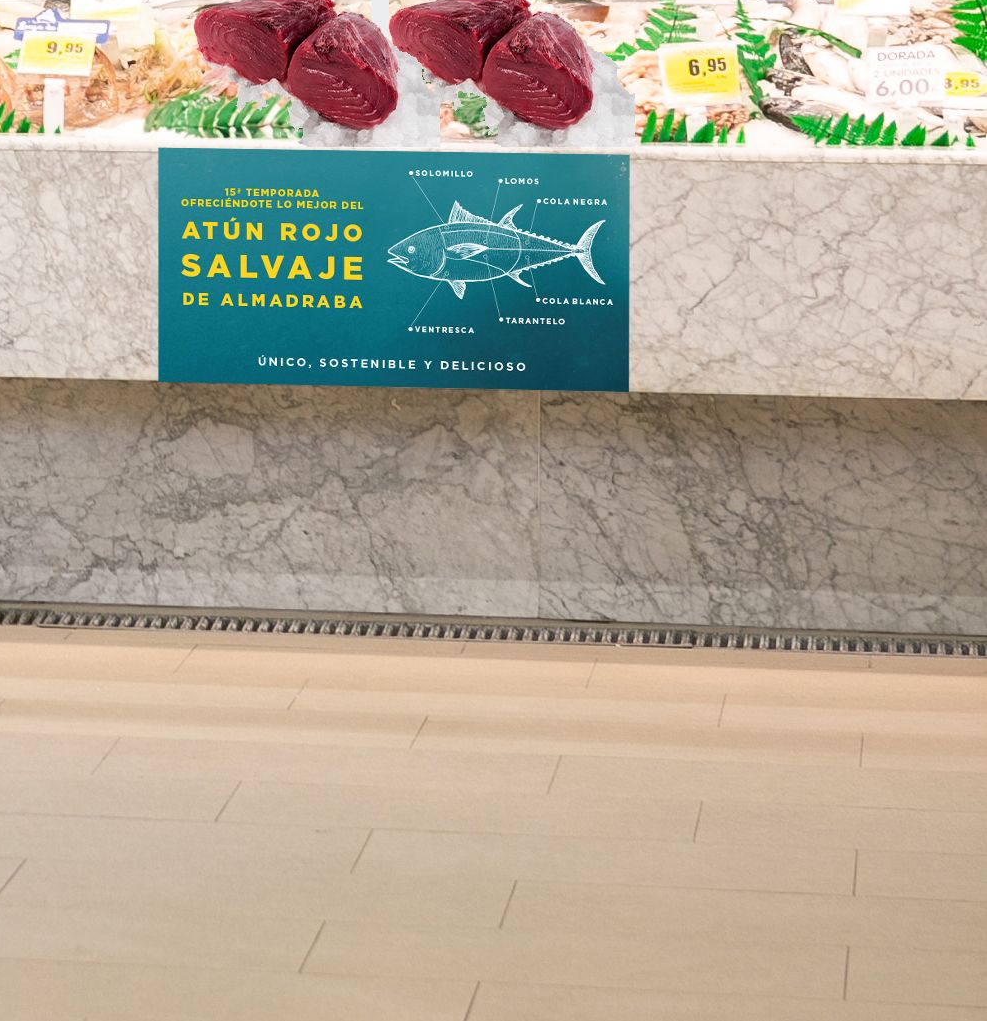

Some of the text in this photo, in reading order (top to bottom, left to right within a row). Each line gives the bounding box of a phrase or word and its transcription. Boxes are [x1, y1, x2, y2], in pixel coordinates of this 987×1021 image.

[46, 41, 83, 56] 9,95
[877, 50, 935, 62] DORADA
[688, 57, 727, 77] 6,95
[415, 169, 474, 178] SOLOMILLO
[504, 177, 540, 185] LOMOS
[246, 188, 320, 197] TEMPORADA
[181, 197, 364, 210] OFRECIÉNDOTE LO MEJOR DEL
[542, 197, 608, 207] COLA NEGRA
[181, 216, 363, 242] ATÚN ROJO
[180, 253, 363, 281] SALVAJE
[182, 292, 363, 309] DE ALMADRABA
[542, 297, 614, 307] COLA BLANCA
[505, 317, 566, 326] TARANTELO
[414, 325, 475, 334] VENTRESCA
[258, 355, 527, 373] ÚNICO, SOSTENIBLE Y DELICIOSO
